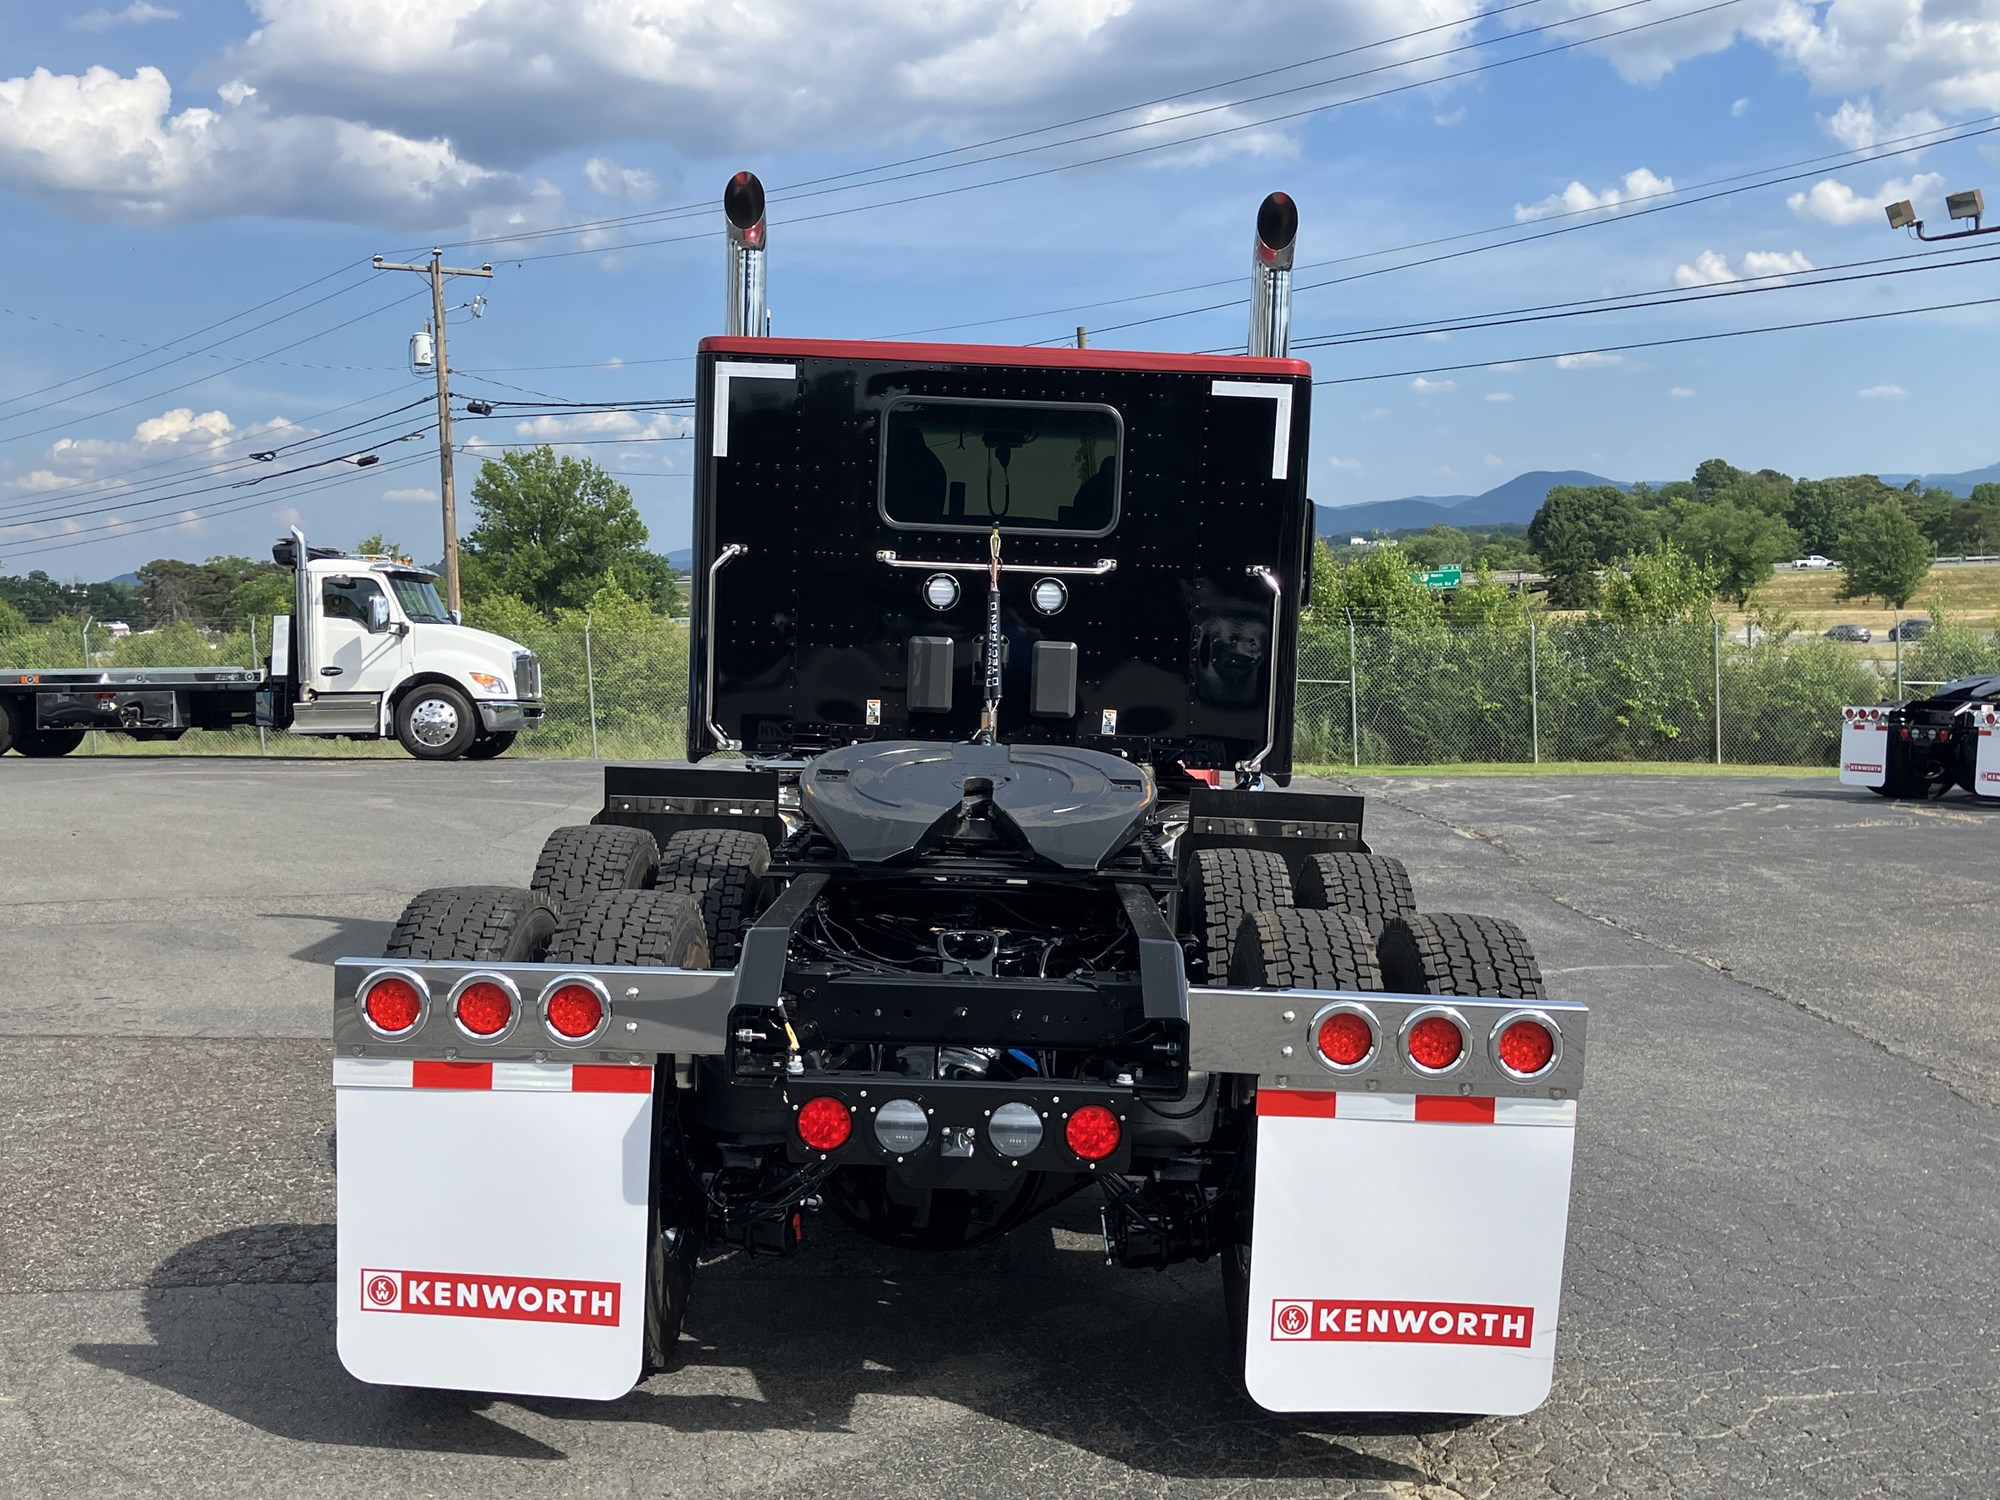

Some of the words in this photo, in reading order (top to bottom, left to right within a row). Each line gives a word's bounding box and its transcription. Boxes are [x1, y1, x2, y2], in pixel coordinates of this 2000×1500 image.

[990, 614, 999, 674] TECTRAN
[1850, 764, 1882, 772] KENWORTH
[409, 1279, 613, 1316] KENWORTH
[1319, 1308, 1525, 1339] KENWORTH
